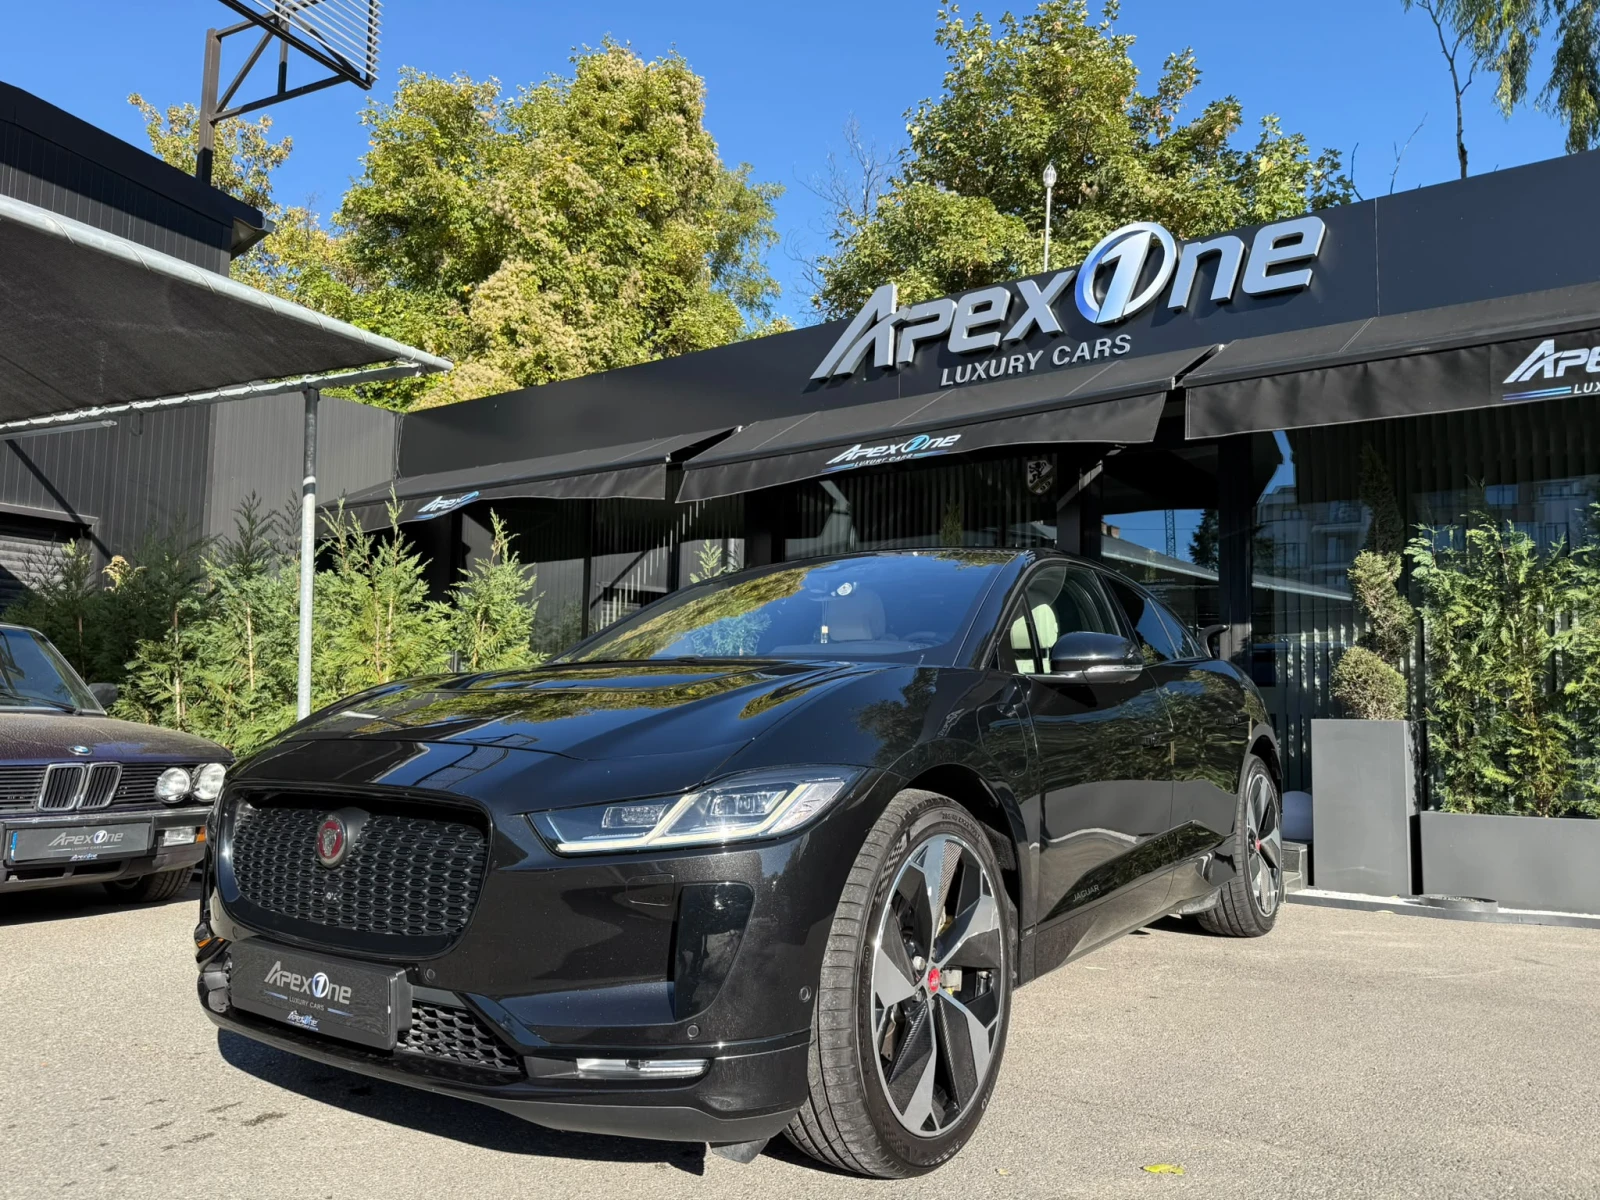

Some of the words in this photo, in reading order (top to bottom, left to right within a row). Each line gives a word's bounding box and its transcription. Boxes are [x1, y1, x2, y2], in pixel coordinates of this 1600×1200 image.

[940, 350, 1044, 387] LUXURY
[1052, 334, 1132, 366] CARS
[854, 456, 887, 468] LUXURY
[1073, 884, 1100, 902] JAGUAR
[309, 1002, 325, 1011] CARS
